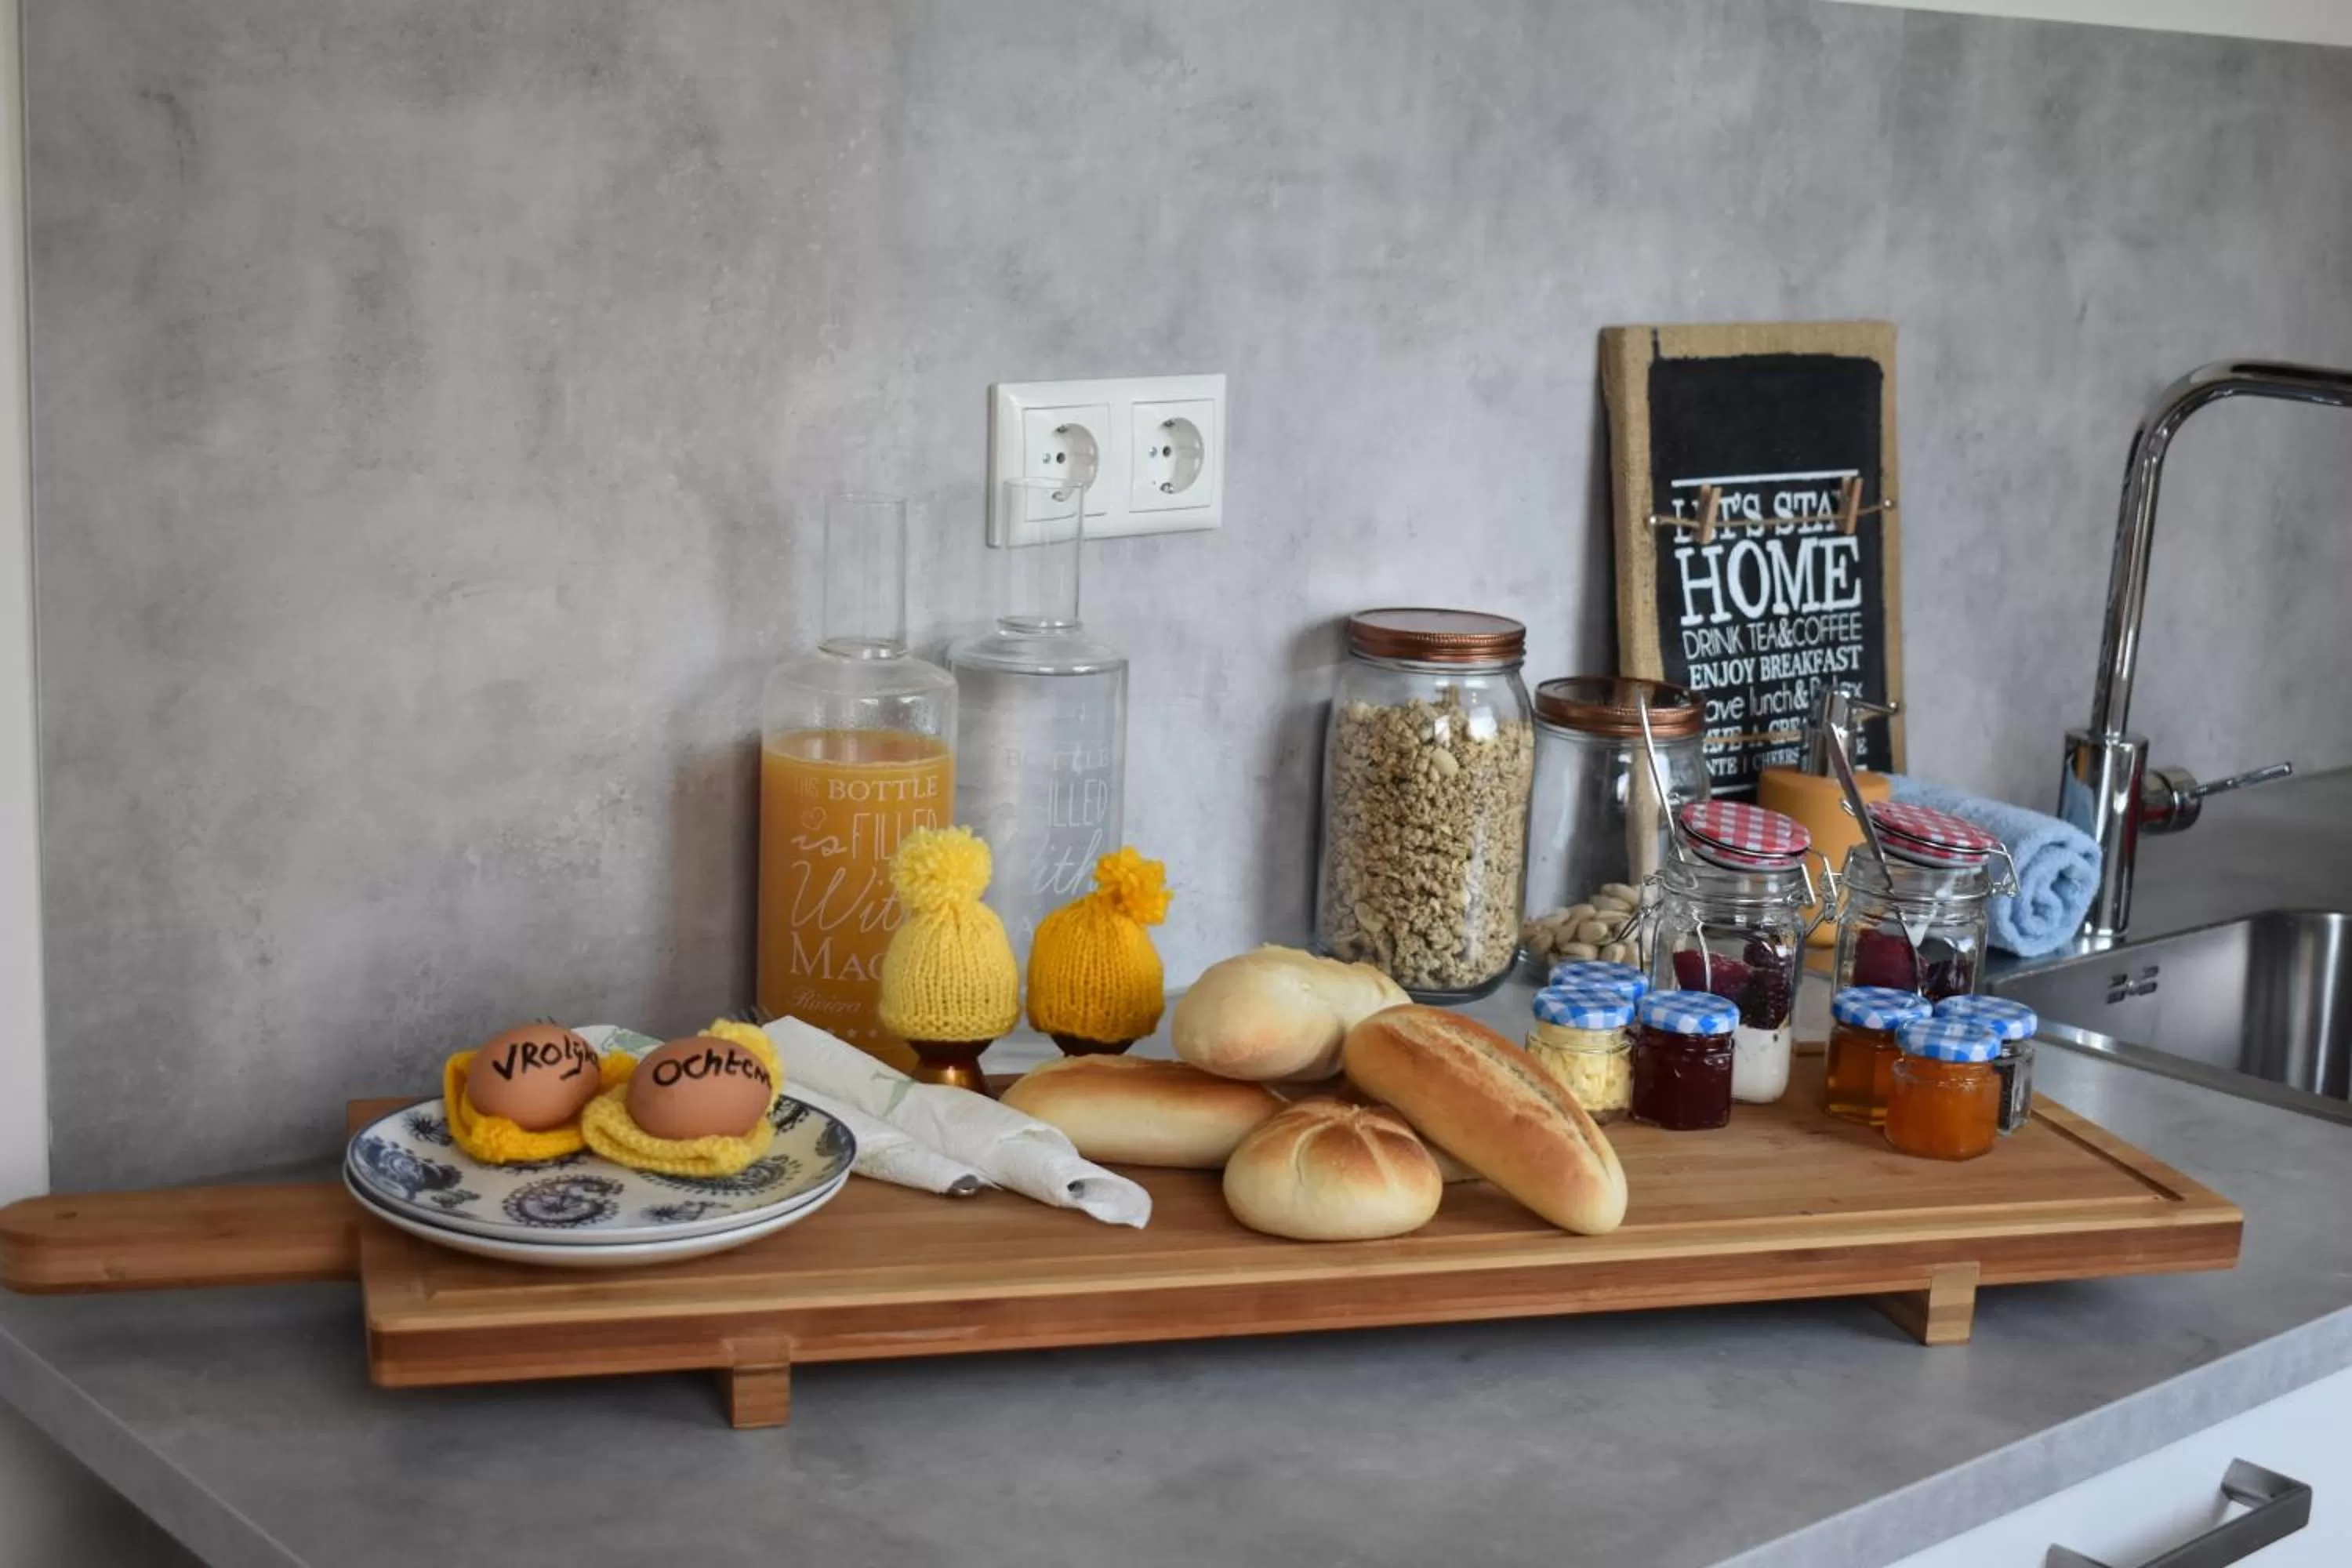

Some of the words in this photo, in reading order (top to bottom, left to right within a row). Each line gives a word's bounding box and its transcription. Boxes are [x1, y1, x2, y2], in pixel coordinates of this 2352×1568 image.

[1671, 492, 1765, 543] LT'S
[1773, 490, 1842, 536] STA
[1675, 536, 1863, 626] HOME
[1682, 626, 1748, 661] DRINK
[1747, 612, 1863, 652] TEA&COFFEE
[1688, 657, 1755, 691] ENJOY
[1759, 644, 1864, 682] BREAKFAST
[1704, 696, 1745, 722] ave
[1702, 725, 1743, 753] AVE
[827, 775, 939, 801] BOTTLE
[789, 860, 903, 934] Wit
